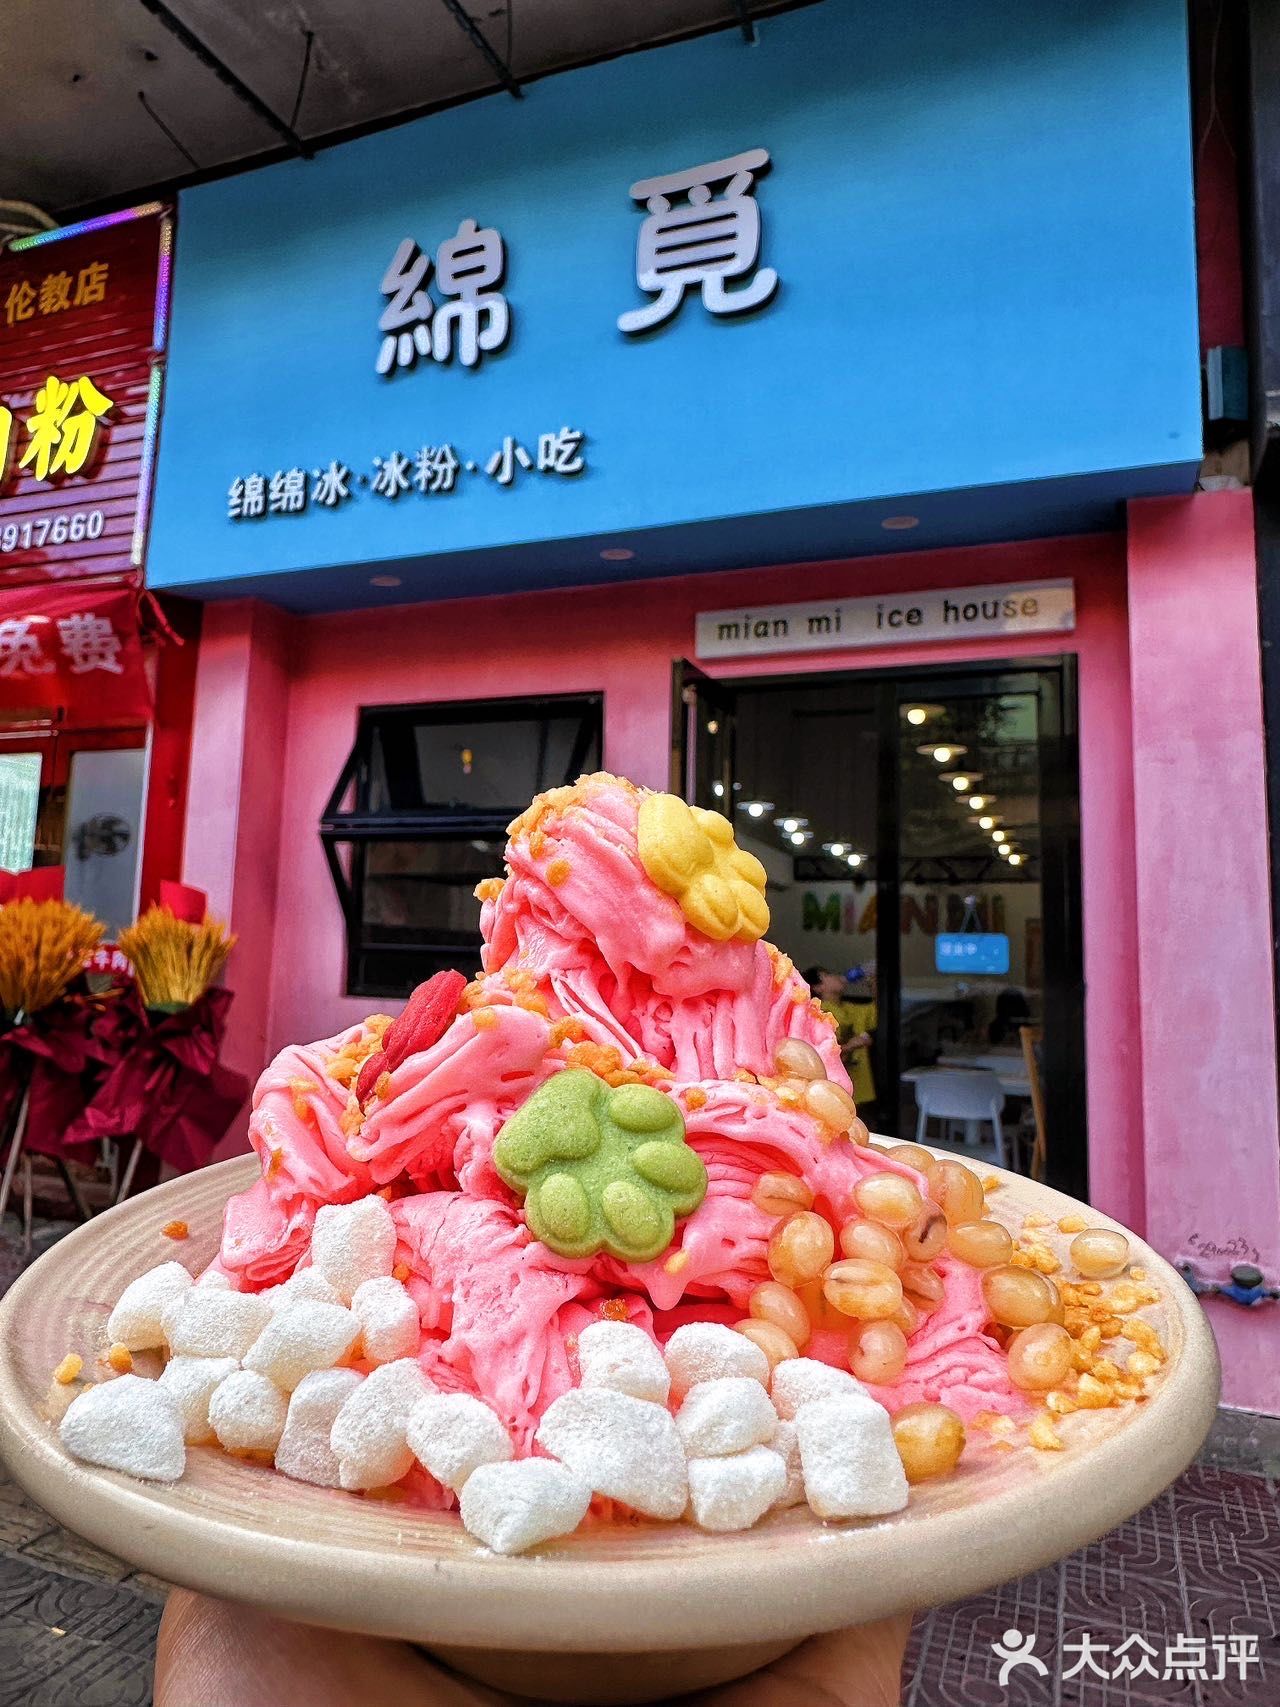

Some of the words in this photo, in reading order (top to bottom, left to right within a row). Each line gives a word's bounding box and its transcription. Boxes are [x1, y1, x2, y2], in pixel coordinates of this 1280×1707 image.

[4, 261, 109, 328] 伦教店
[0, 375, 114, 482] 粉
[0, 510, 105, 553] 917660
[0, 613, 124, 676] 免费
[717, 614, 790, 641] mian
[807, 608, 842, 634] mi
[876, 603, 924, 629] ice
[942, 596, 1039, 624] house
